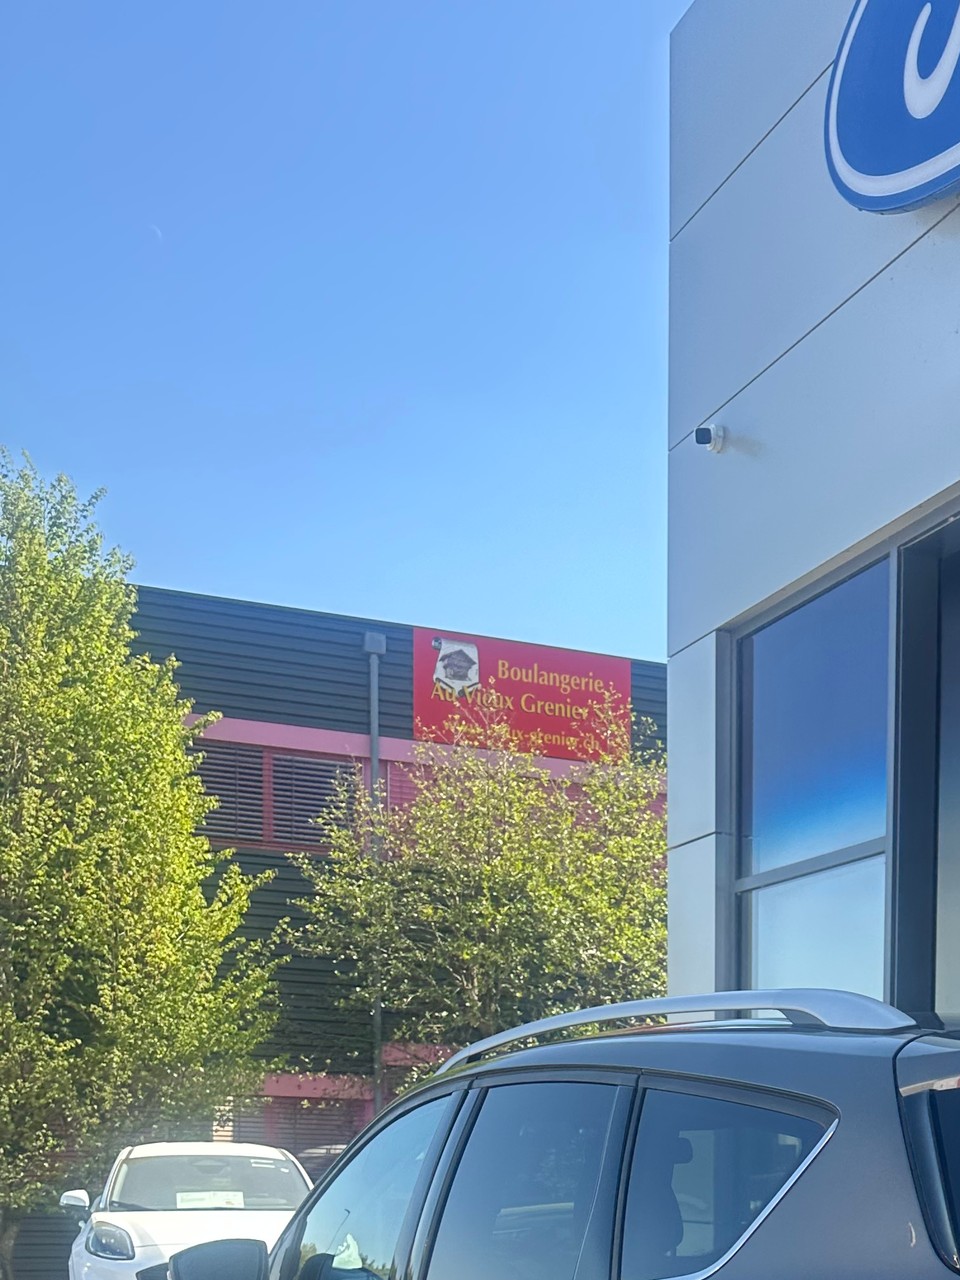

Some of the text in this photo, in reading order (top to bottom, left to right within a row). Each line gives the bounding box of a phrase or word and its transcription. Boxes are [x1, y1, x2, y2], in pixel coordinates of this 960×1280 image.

[498, 660, 605, 694] Boulangerie
[431, 682, 456, 702] Au
[464, 684, 513, 709] Vieux
[520, 692, 588, 719] Grenier
